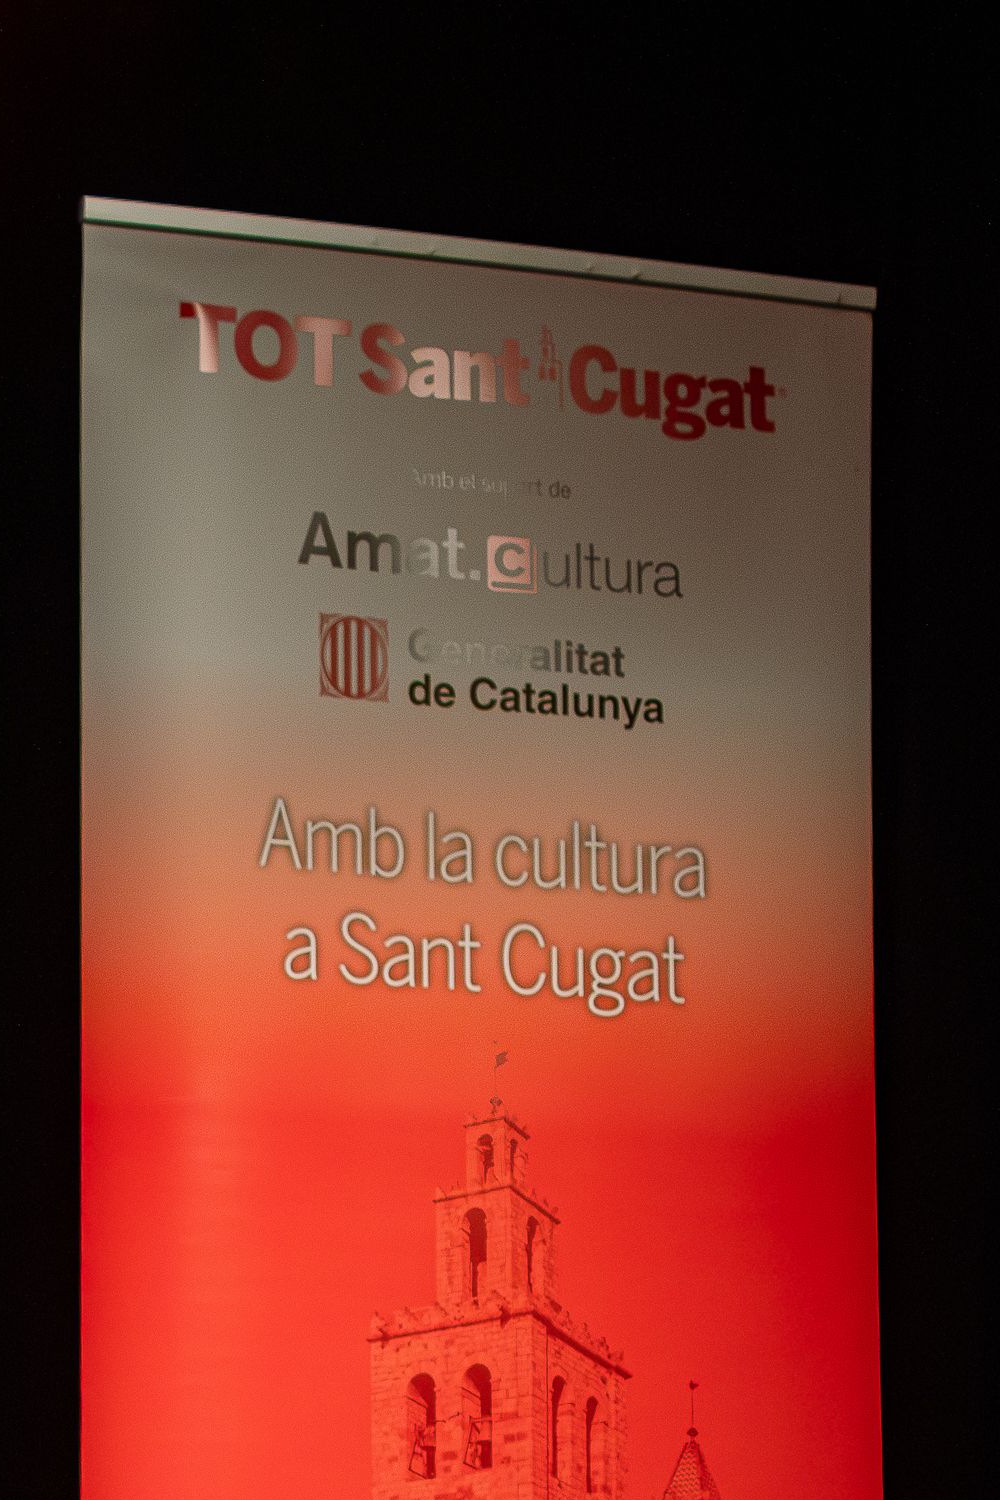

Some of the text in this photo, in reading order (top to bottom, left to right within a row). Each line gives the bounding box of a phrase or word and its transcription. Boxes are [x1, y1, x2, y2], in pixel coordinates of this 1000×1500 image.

[179, 301, 776, 441] TOT Sant Cugat
[481, 477, 543, 501] suprt
[548, 480, 572, 499] de
[407, 626, 626, 679] Generalitat
[408, 673, 665, 730] de Catalunya
[258, 797, 707, 899] Amb la cultura
[283, 910, 686, 1018] a Sant Cugat
